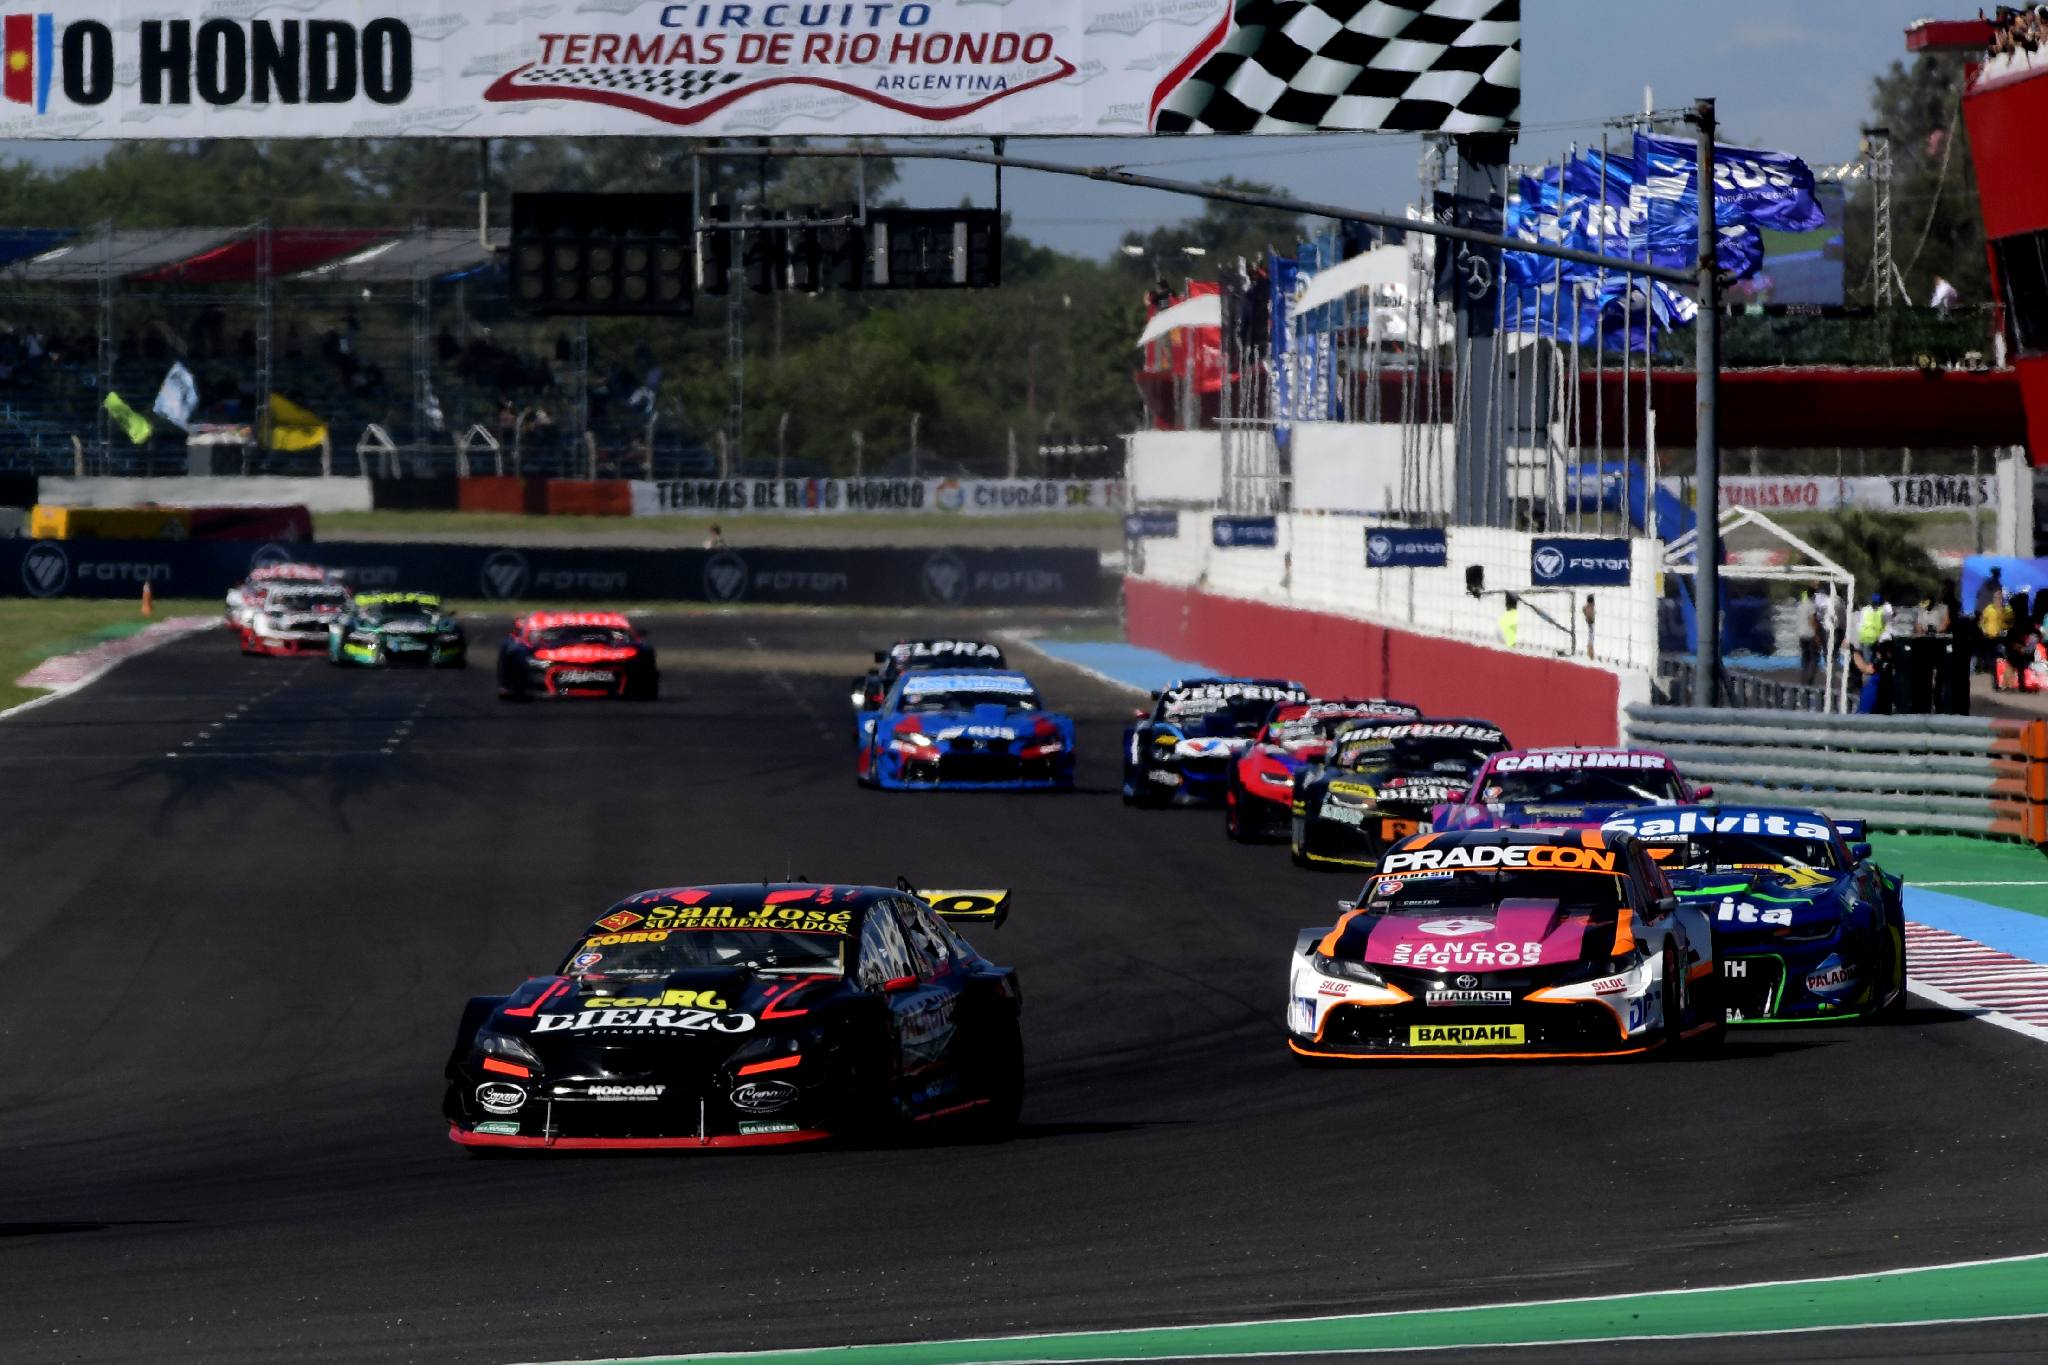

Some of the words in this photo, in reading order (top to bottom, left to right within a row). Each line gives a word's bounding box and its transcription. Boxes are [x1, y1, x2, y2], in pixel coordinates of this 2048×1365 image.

[659, 3, 931, 28] CIRCUITO
[538, 33, 727, 65] TERMAS
[737, 33, 794, 65] DE
[889, 32, 1053, 65] HONDO
[140, 17, 412, 105] HONDO
[876, 73, 1008, 91] ARGENTINA
[657, 481, 747, 508] TERMAS
[754, 482, 780, 508] DE
[845, 480, 924, 508] HONDO
[1600, 812, 1832, 841] Salvita
[1383, 845, 1616, 874] PRADECON
[647, 905, 733, 921] San
[748, 904, 852, 924] José
[643, 917, 849, 933] SUPERMERCADOS
[584, 932, 669, 947] COIRO
[1394, 941, 1543, 954] SANCOR
[1392, 951, 1541, 966] SEGUROS
[1418, 1026, 1518, 1043] BARDAHL
